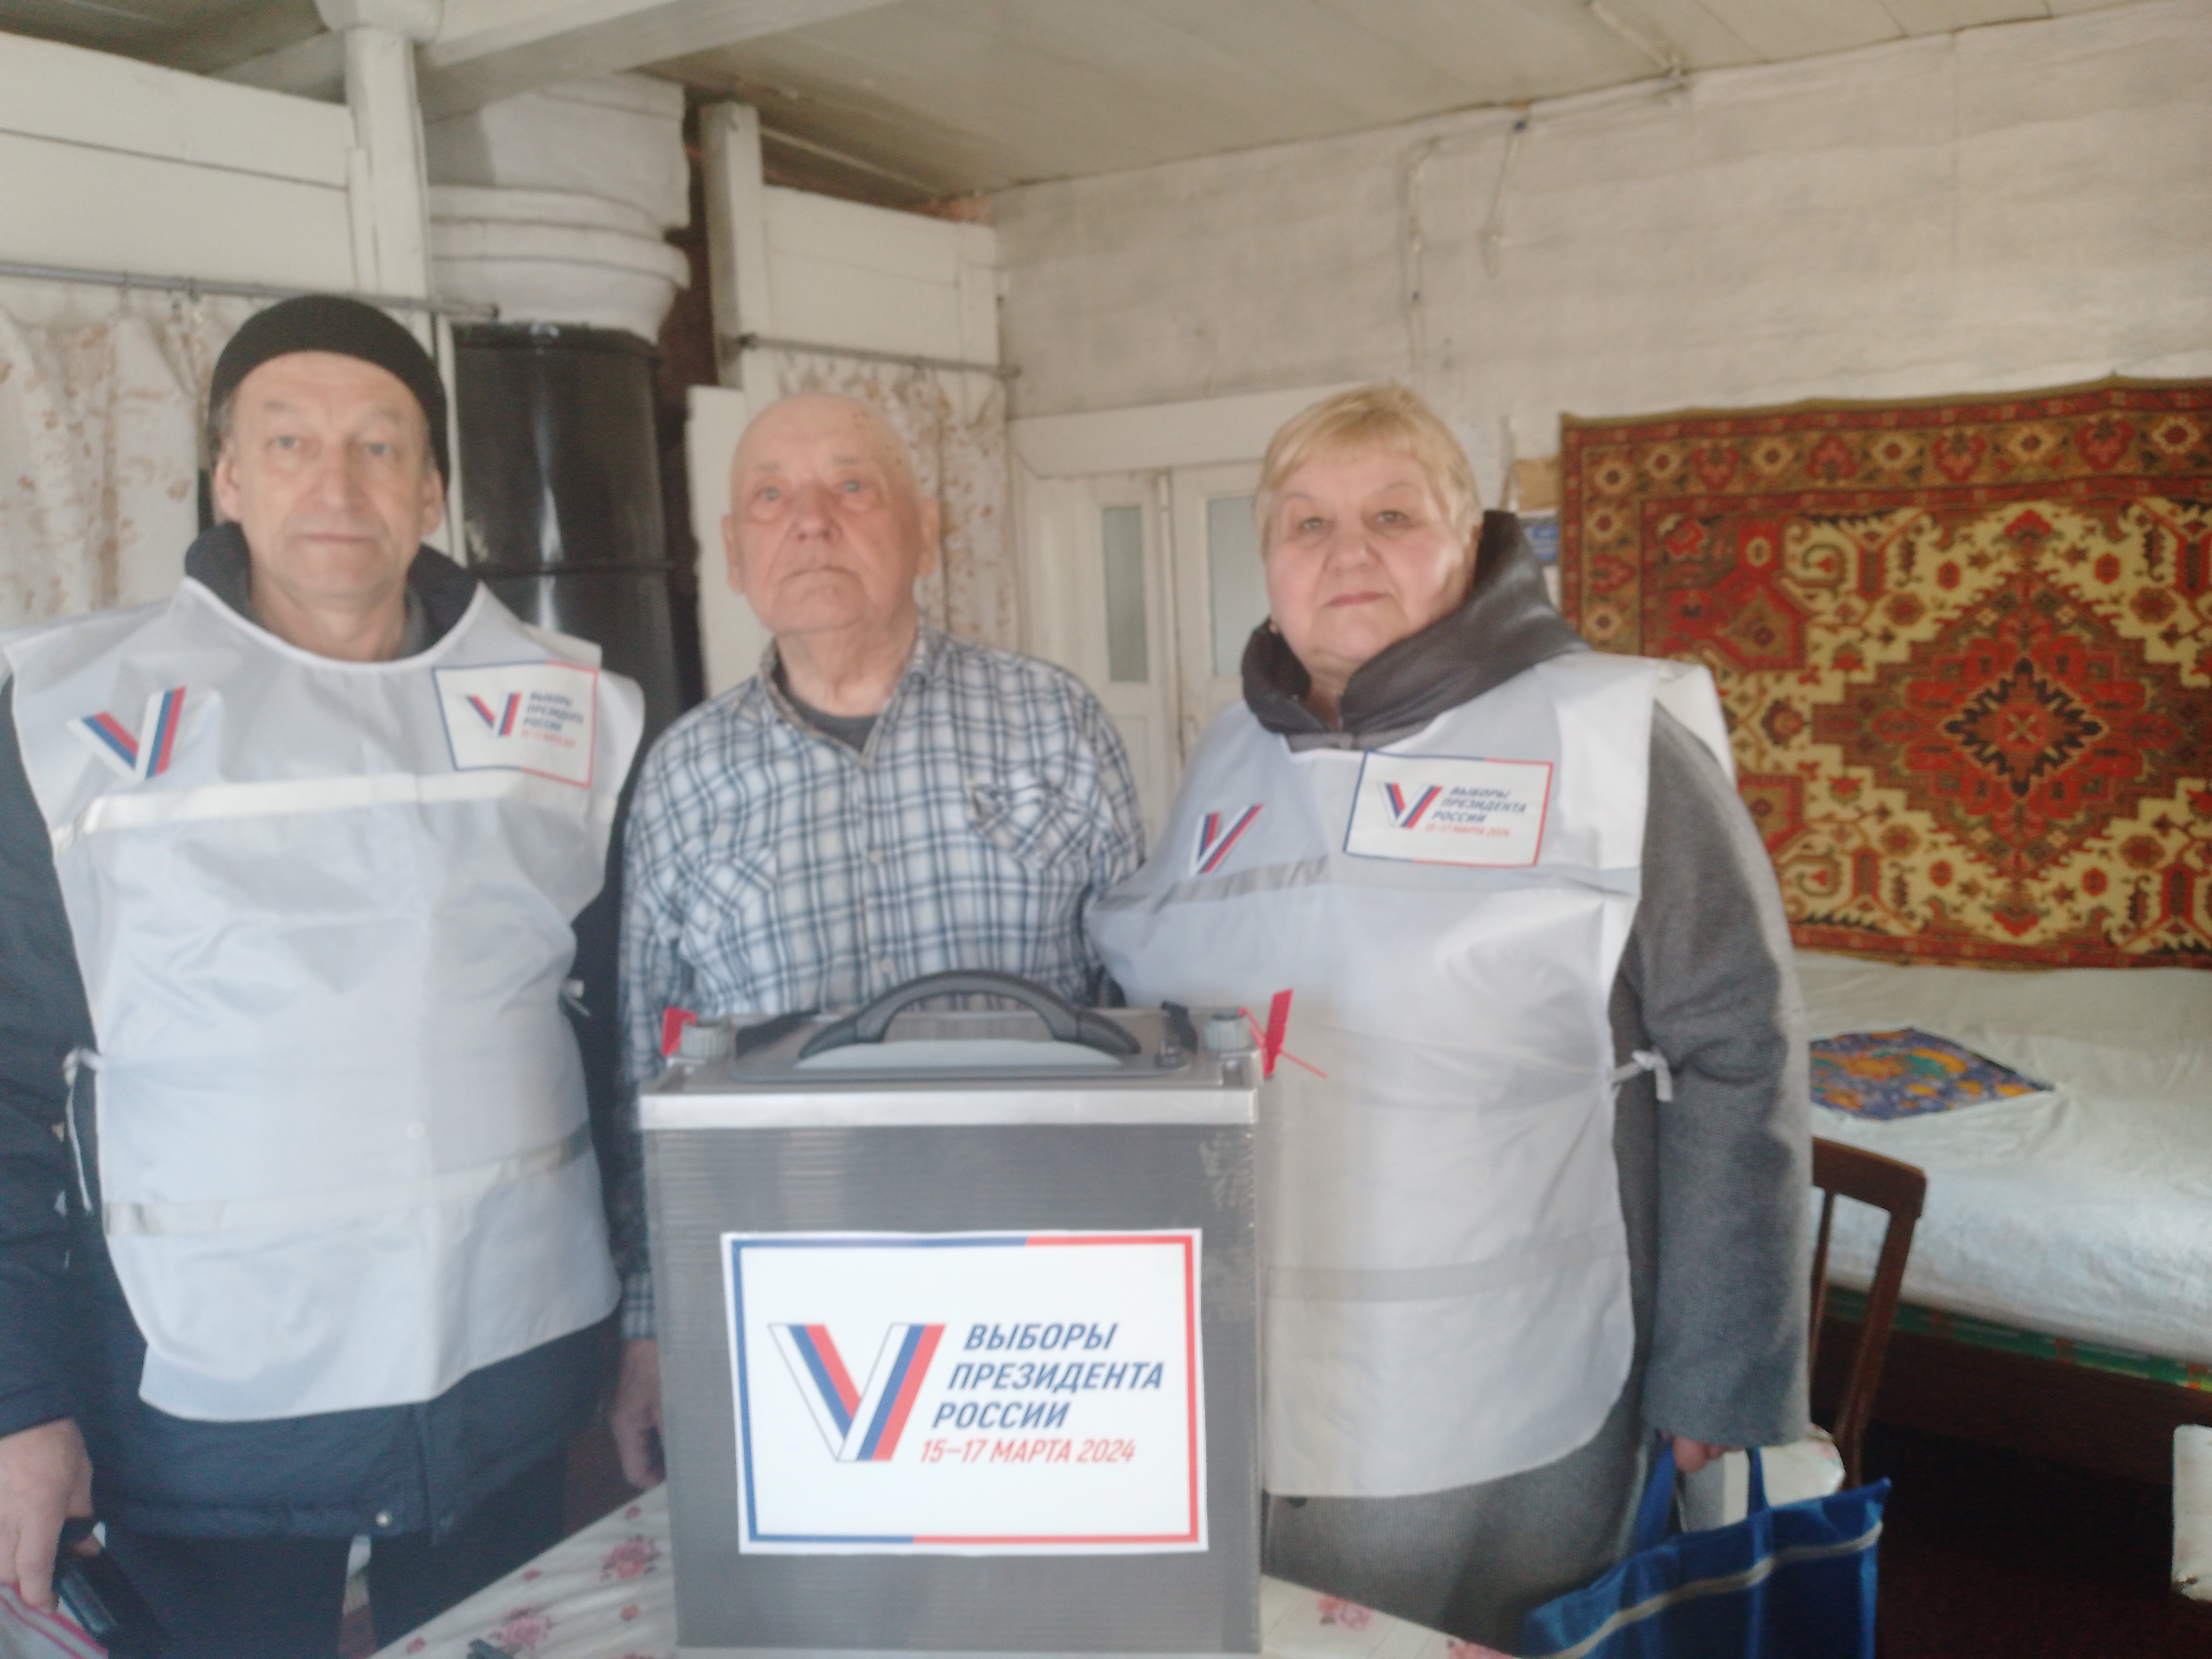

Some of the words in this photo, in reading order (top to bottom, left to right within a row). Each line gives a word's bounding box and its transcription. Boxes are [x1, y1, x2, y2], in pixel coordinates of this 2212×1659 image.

[963, 1322, 1119, 1351] ВЫБОРЫ
[946, 1362, 1164, 1394] ПРЕЗИДЕНТА
[932, 1402, 1071, 1429] РОССИИ
[989, 1439, 1073, 1463] МАРТА
[1075, 1439, 1136, 1463] 2024
